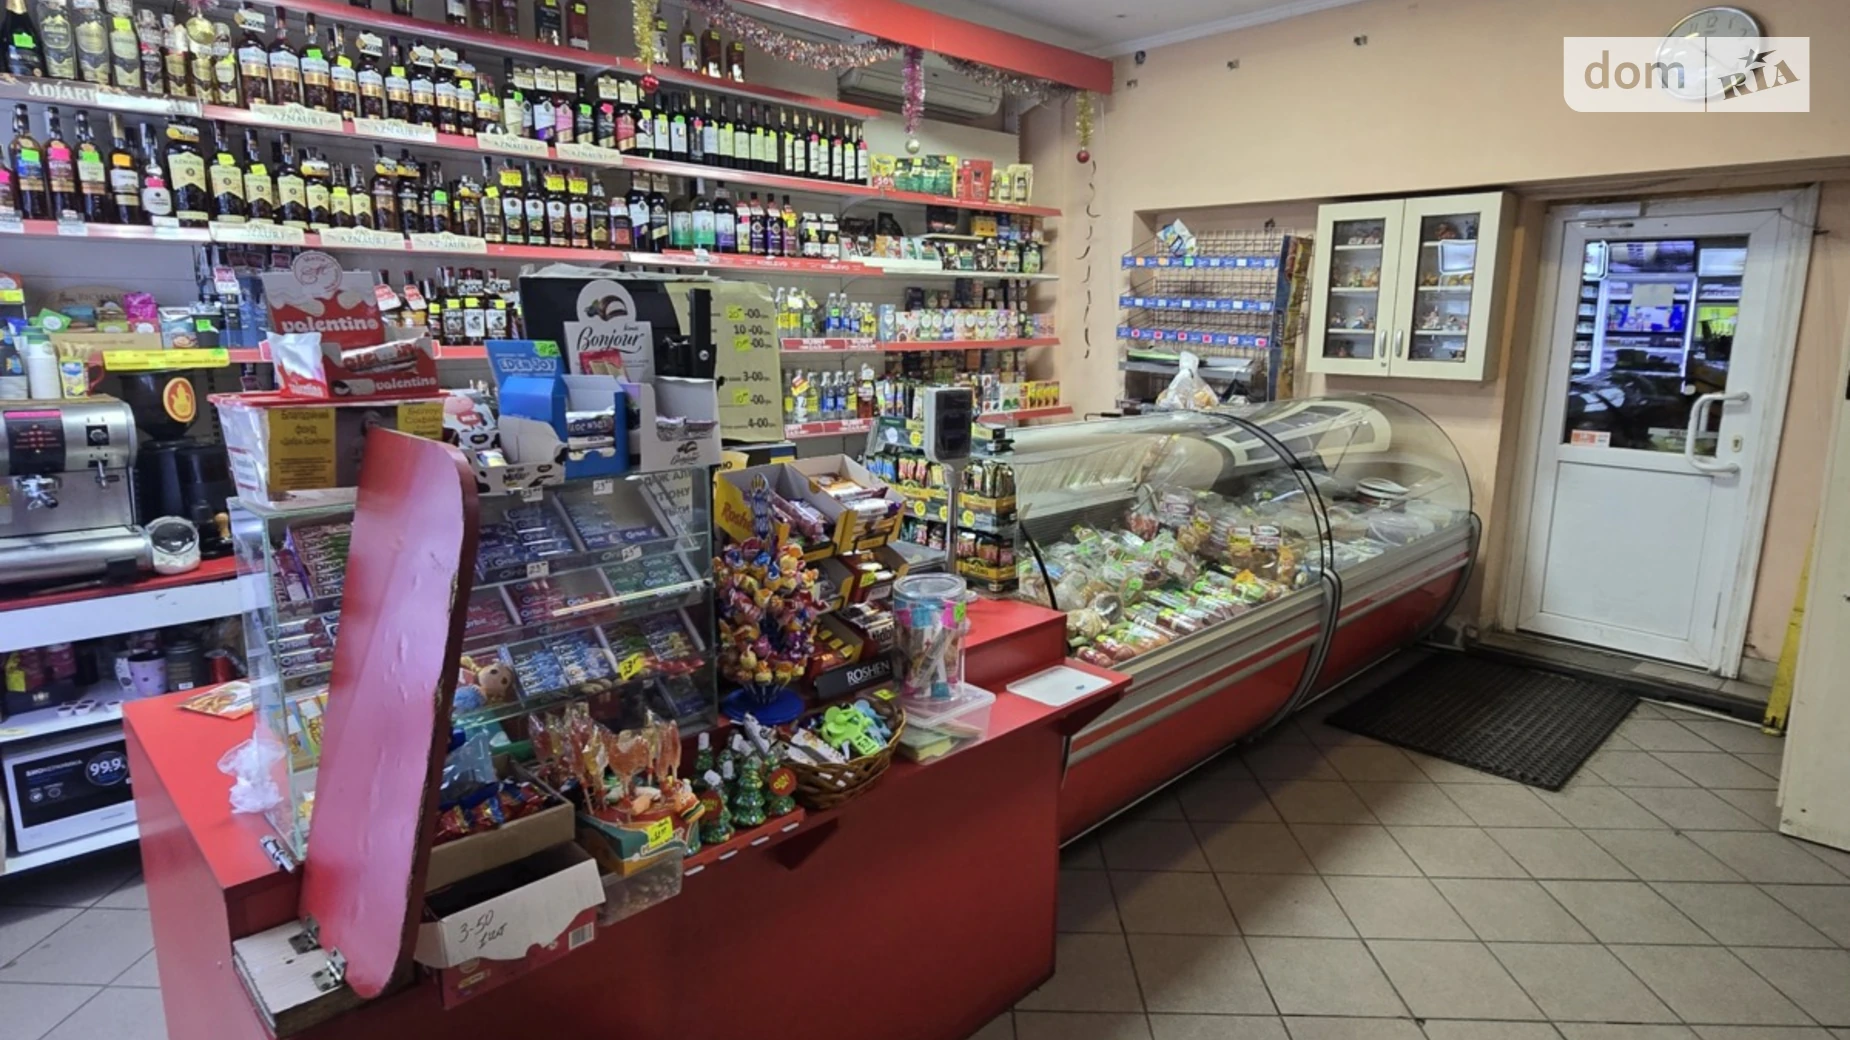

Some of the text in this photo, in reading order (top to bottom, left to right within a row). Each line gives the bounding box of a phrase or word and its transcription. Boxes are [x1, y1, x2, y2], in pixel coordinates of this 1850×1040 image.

[281, 316, 379, 333] valentino
[576, 327, 646, 354] Bonjour
[375, 377, 438, 391] valentino
[846, 660, 890, 685] ROSHEN
[458, 909, 494, 943] 3-50
